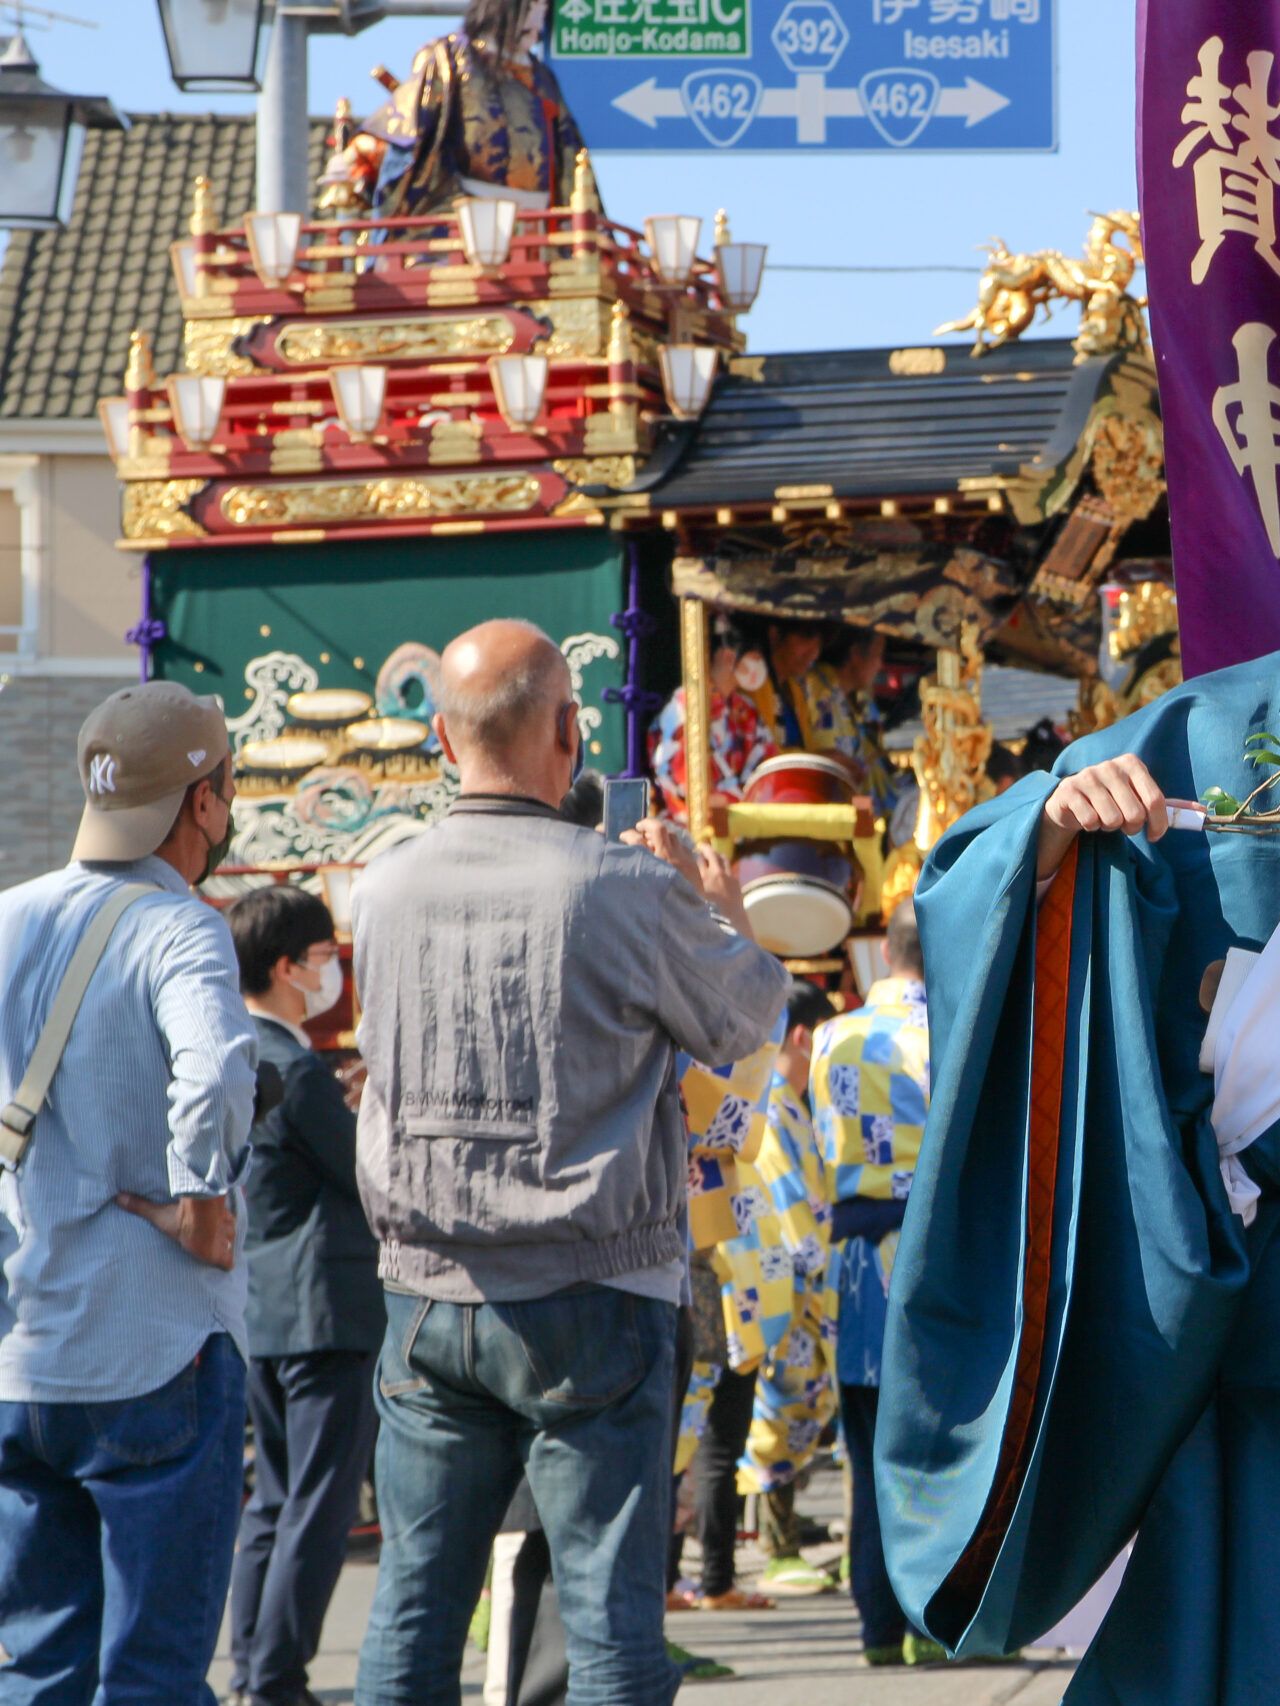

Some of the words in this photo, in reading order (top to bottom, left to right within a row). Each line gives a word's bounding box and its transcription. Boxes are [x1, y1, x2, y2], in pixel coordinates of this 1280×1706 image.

[561, 27, 741, 55] Honjo-Kodama
[781, 19, 837, 54] 392
[904, 29, 1009, 59] Isesaki
[694, 83, 749, 118] 462
[871, 83, 928, 118] 462
